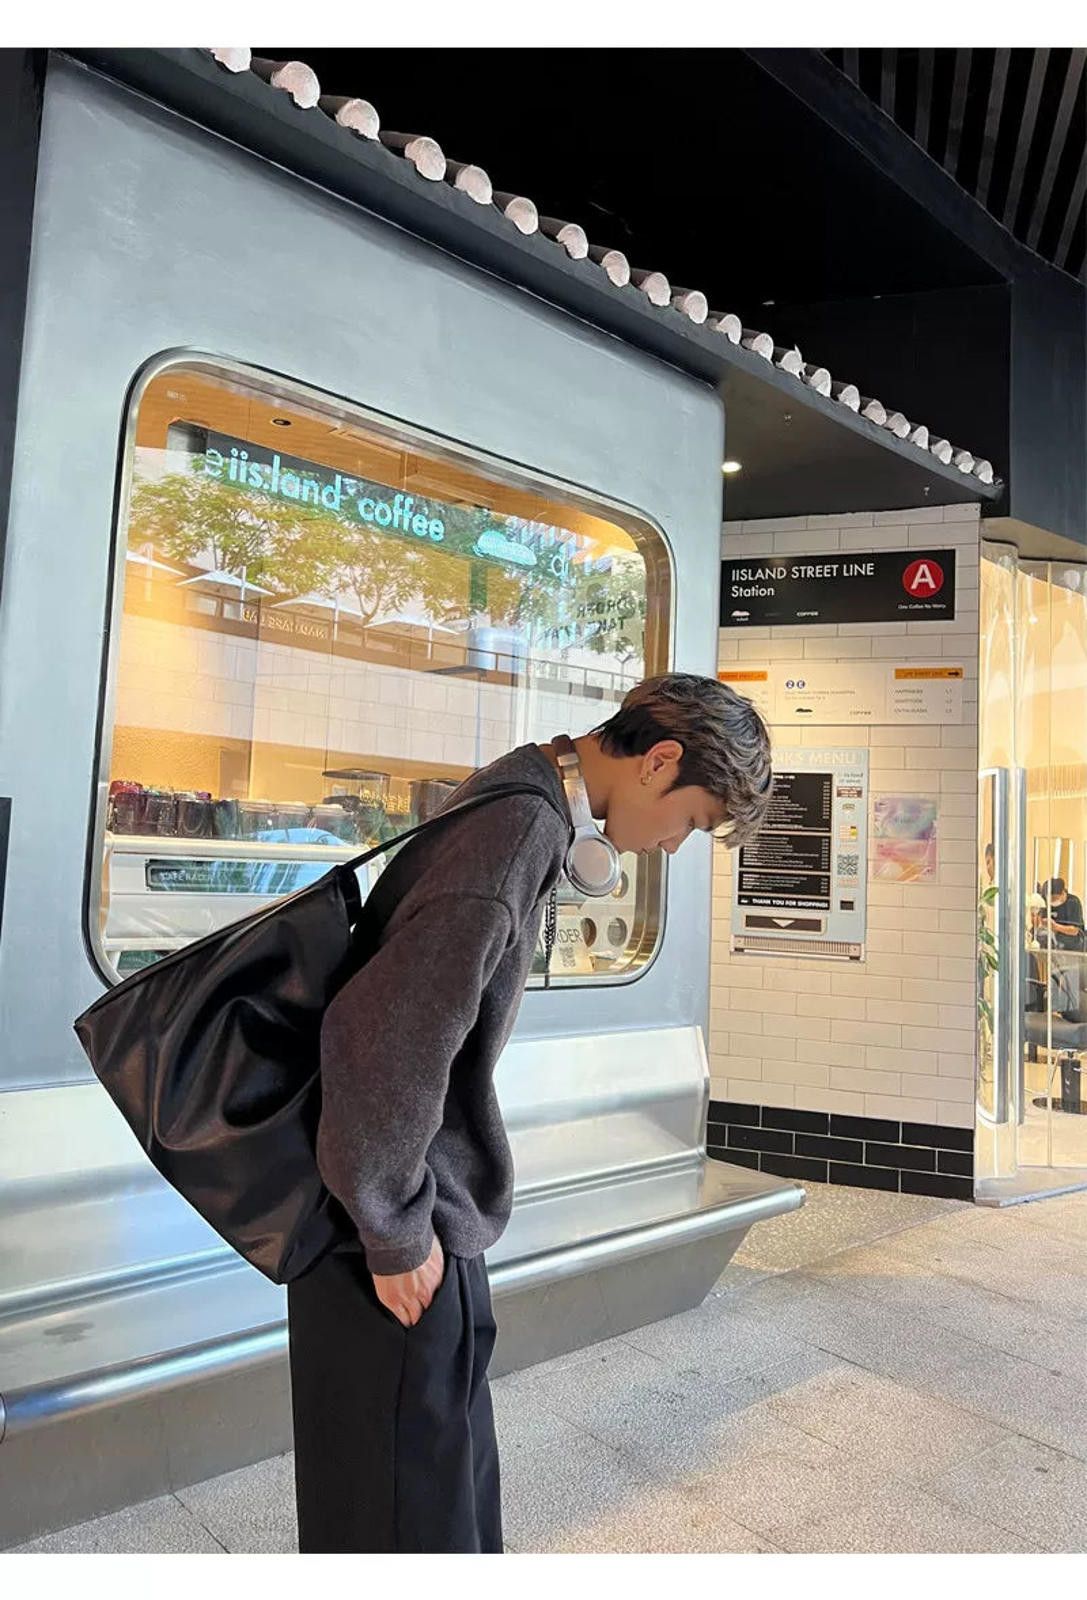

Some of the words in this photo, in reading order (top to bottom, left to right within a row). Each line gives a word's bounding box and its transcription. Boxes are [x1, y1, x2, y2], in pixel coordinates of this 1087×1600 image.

[358, 493, 445, 542] coffee
[731, 567, 787, 582] IISLAND
[791, 563, 839, 579] STREET
[843, 562, 875, 577] LINE
[910, 564, 936, 590] A
[731, 584, 775, 598] Station
[808, 751, 857, 765] MENU
